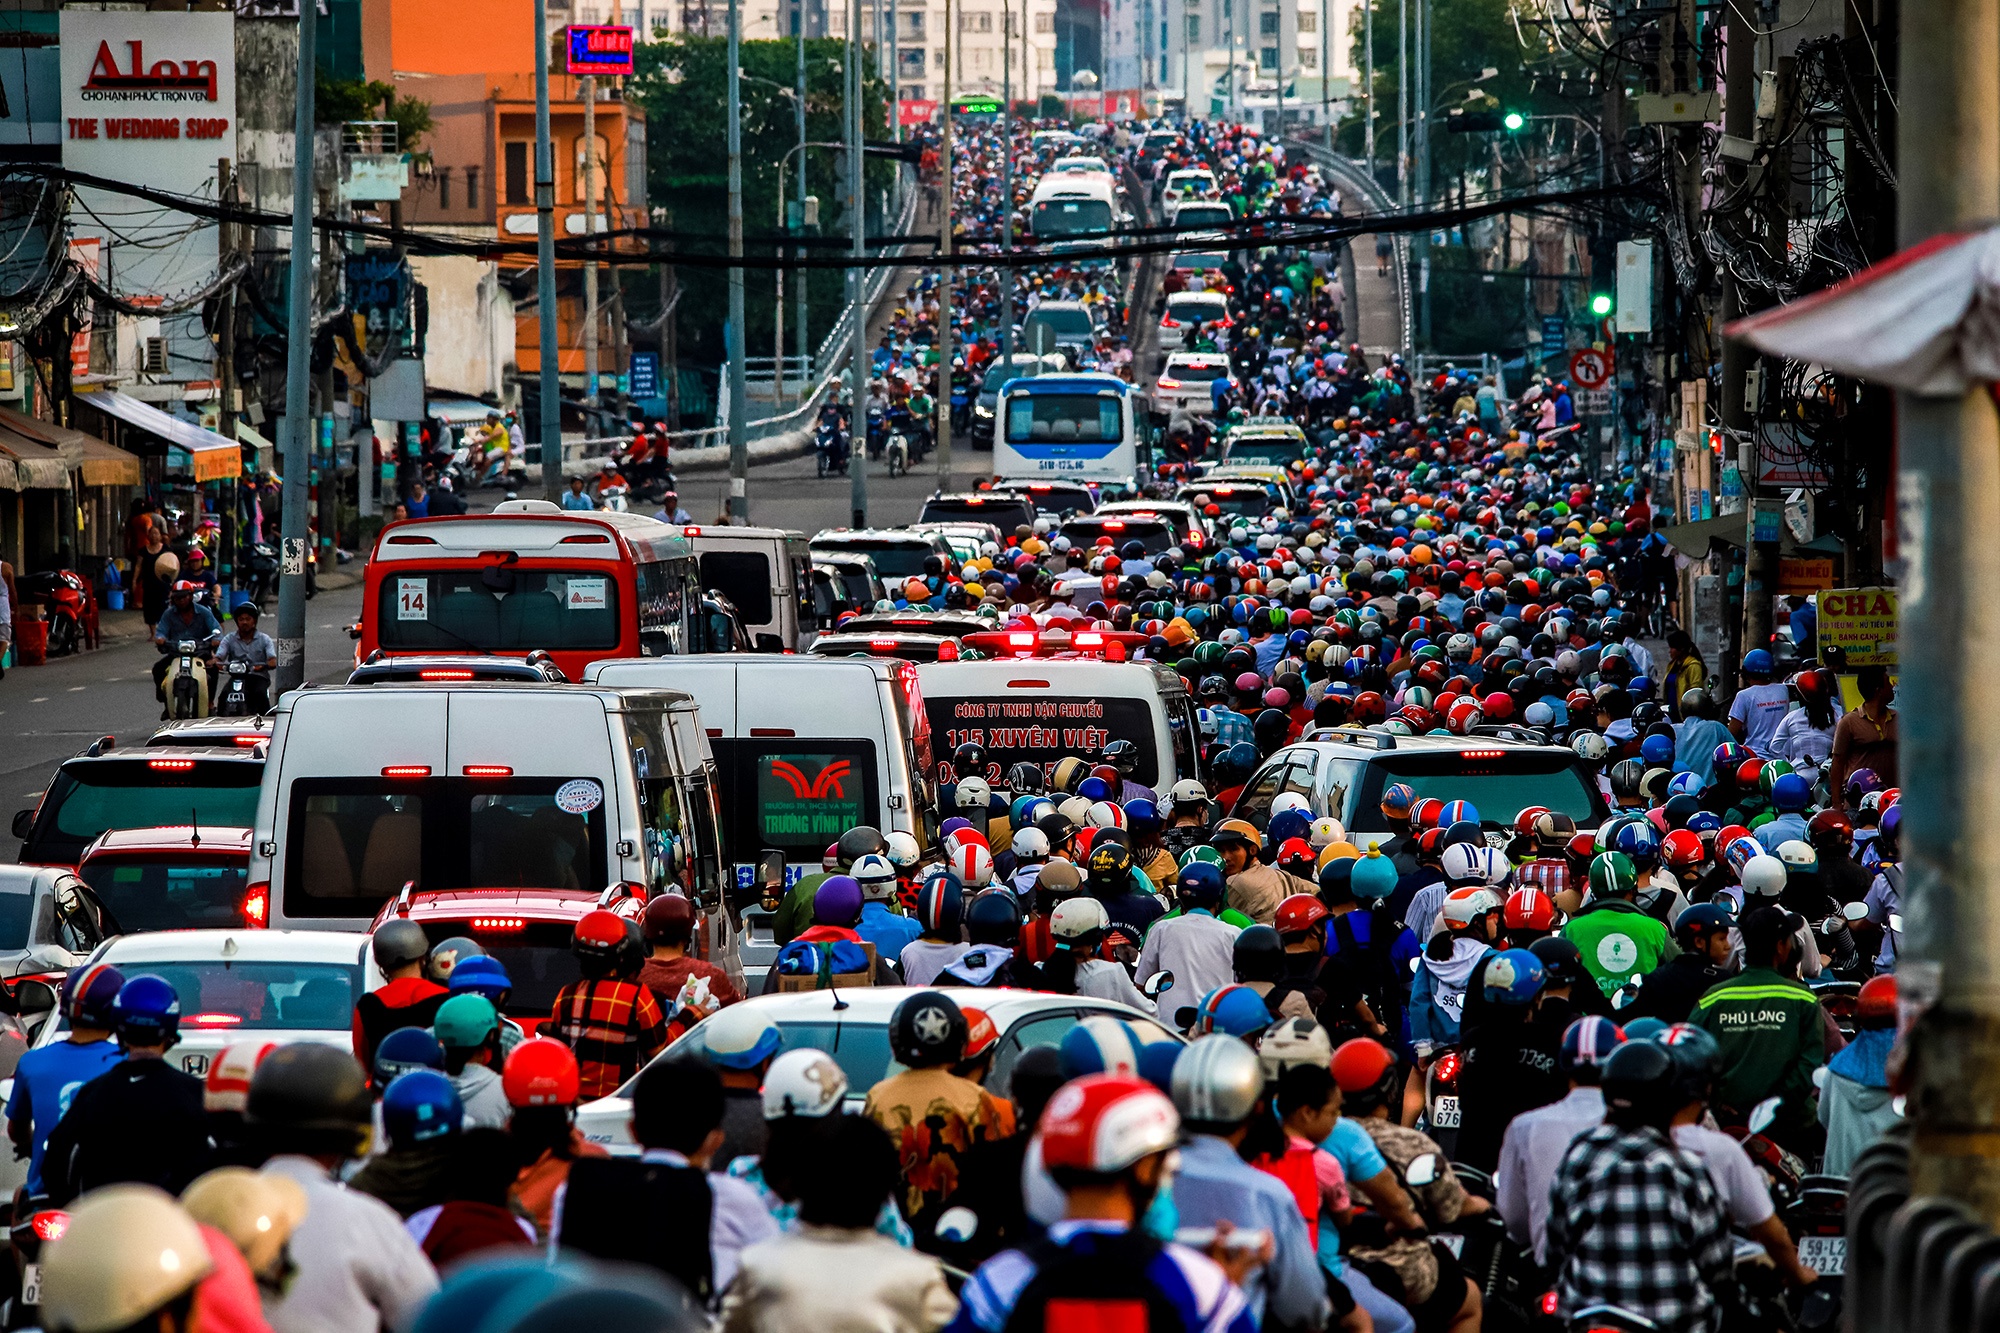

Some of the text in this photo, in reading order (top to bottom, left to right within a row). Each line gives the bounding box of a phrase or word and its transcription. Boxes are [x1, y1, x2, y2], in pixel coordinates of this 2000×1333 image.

[81, 91, 104, 101] CHO
[105, 91, 132, 102] HẠNH
[160, 91, 187, 102] TRỌN
[188, 91, 208, 102] VẸN
[68, 117, 229, 139] THE WEDDING SHOP
[401, 593, 425, 612] 14
[1823, 594, 1898, 616] CHA
[955, 699, 1103, 720] CÔNG TY TNHH VẬN CHUYỂN
[946, 724, 1110, 753] 115 XUYÊN VIỆT
[1719, 1005, 1787, 1025] PHÚ LONG
[1442, 1098, 1456, 1112] 59
[1436, 1111, 1460, 1126] 676
